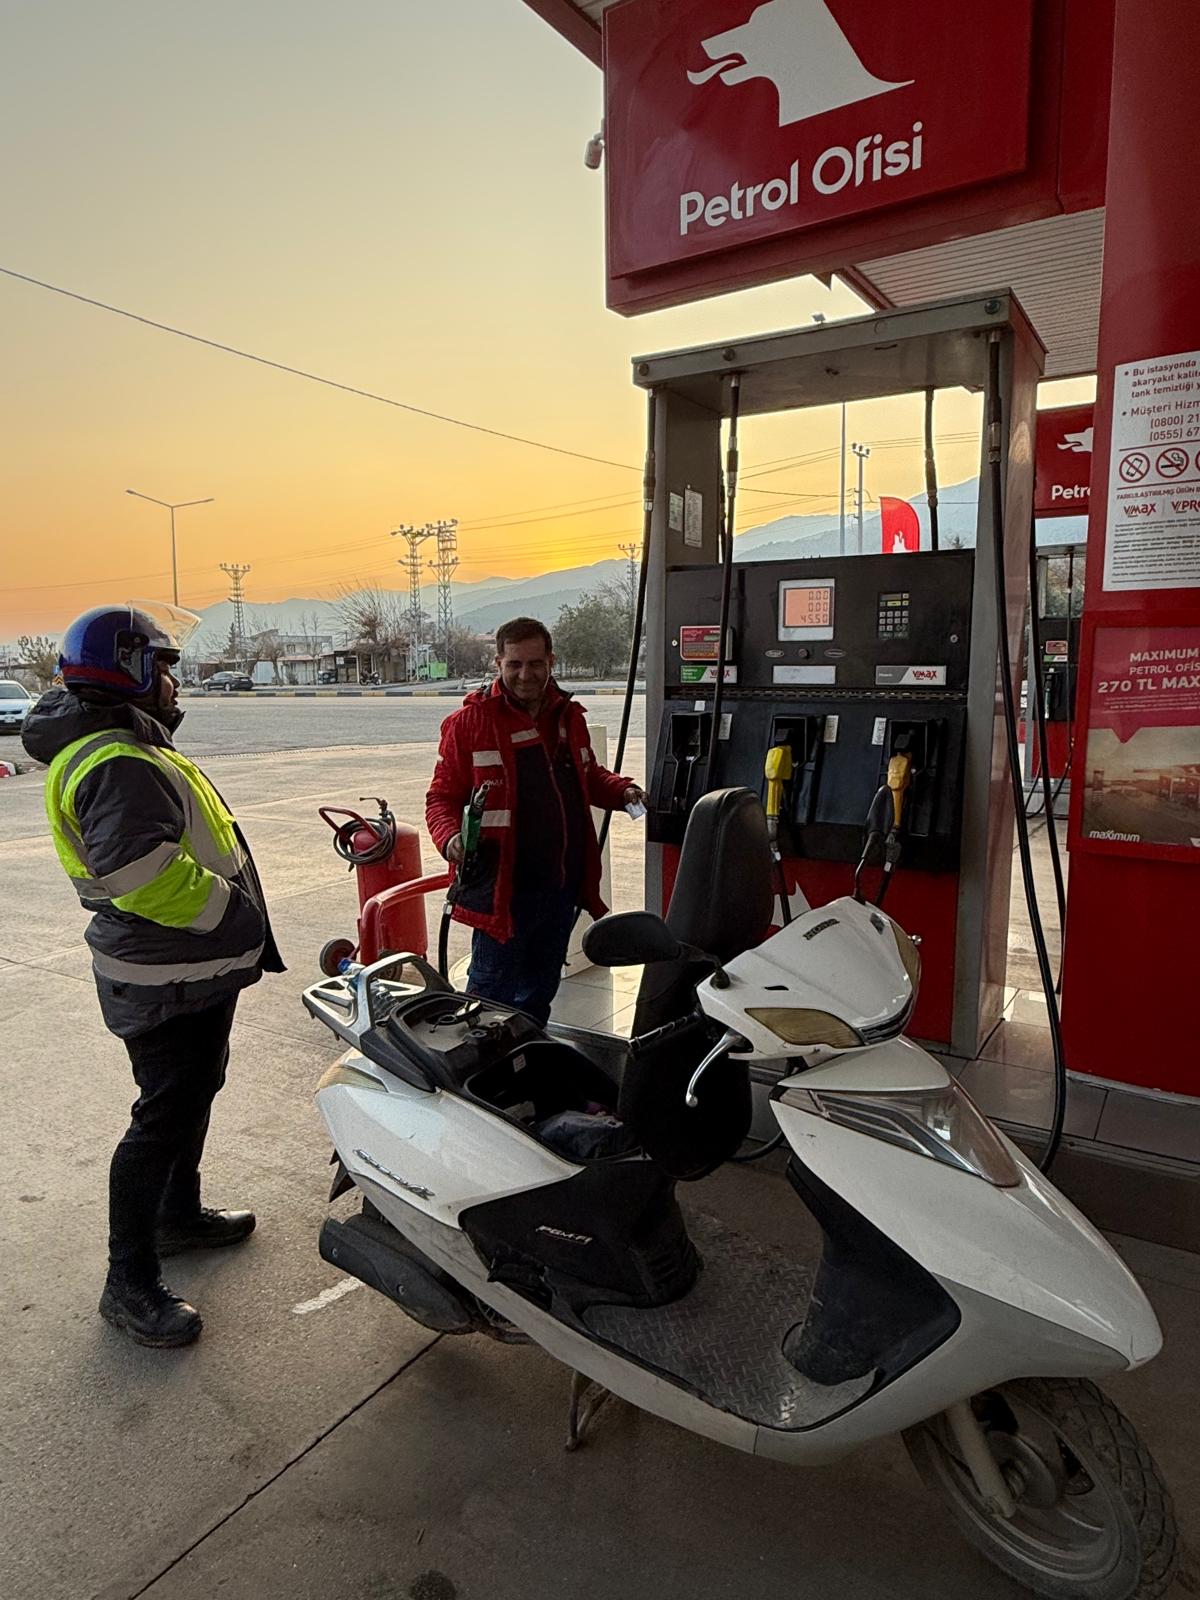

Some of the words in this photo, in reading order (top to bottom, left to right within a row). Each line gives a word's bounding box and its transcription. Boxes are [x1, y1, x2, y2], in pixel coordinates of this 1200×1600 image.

[680, 160, 799, 236] Petrol
[811, 121, 924, 194] Ofisi
[1132, 368, 1145, 377] Bu
[1147, 360, 1197, 374] istasyonda
[1132, 375, 1174, 388] akaryakıt
[1177, 371, 1200, 380] kalit
[1131, 388, 1151, 398] tank
[1130, 401, 1172, 417] Müşteri
[1150, 414, 1184, 429] (0800)
[1149, 428, 1183, 441] (0555)
[1129, 648, 1199, 662] MAXIMUM
[1129, 664, 1172, 675] PETROL
[1098, 680, 1132, 693] 270
[1136, 678, 1157, 690] TL
